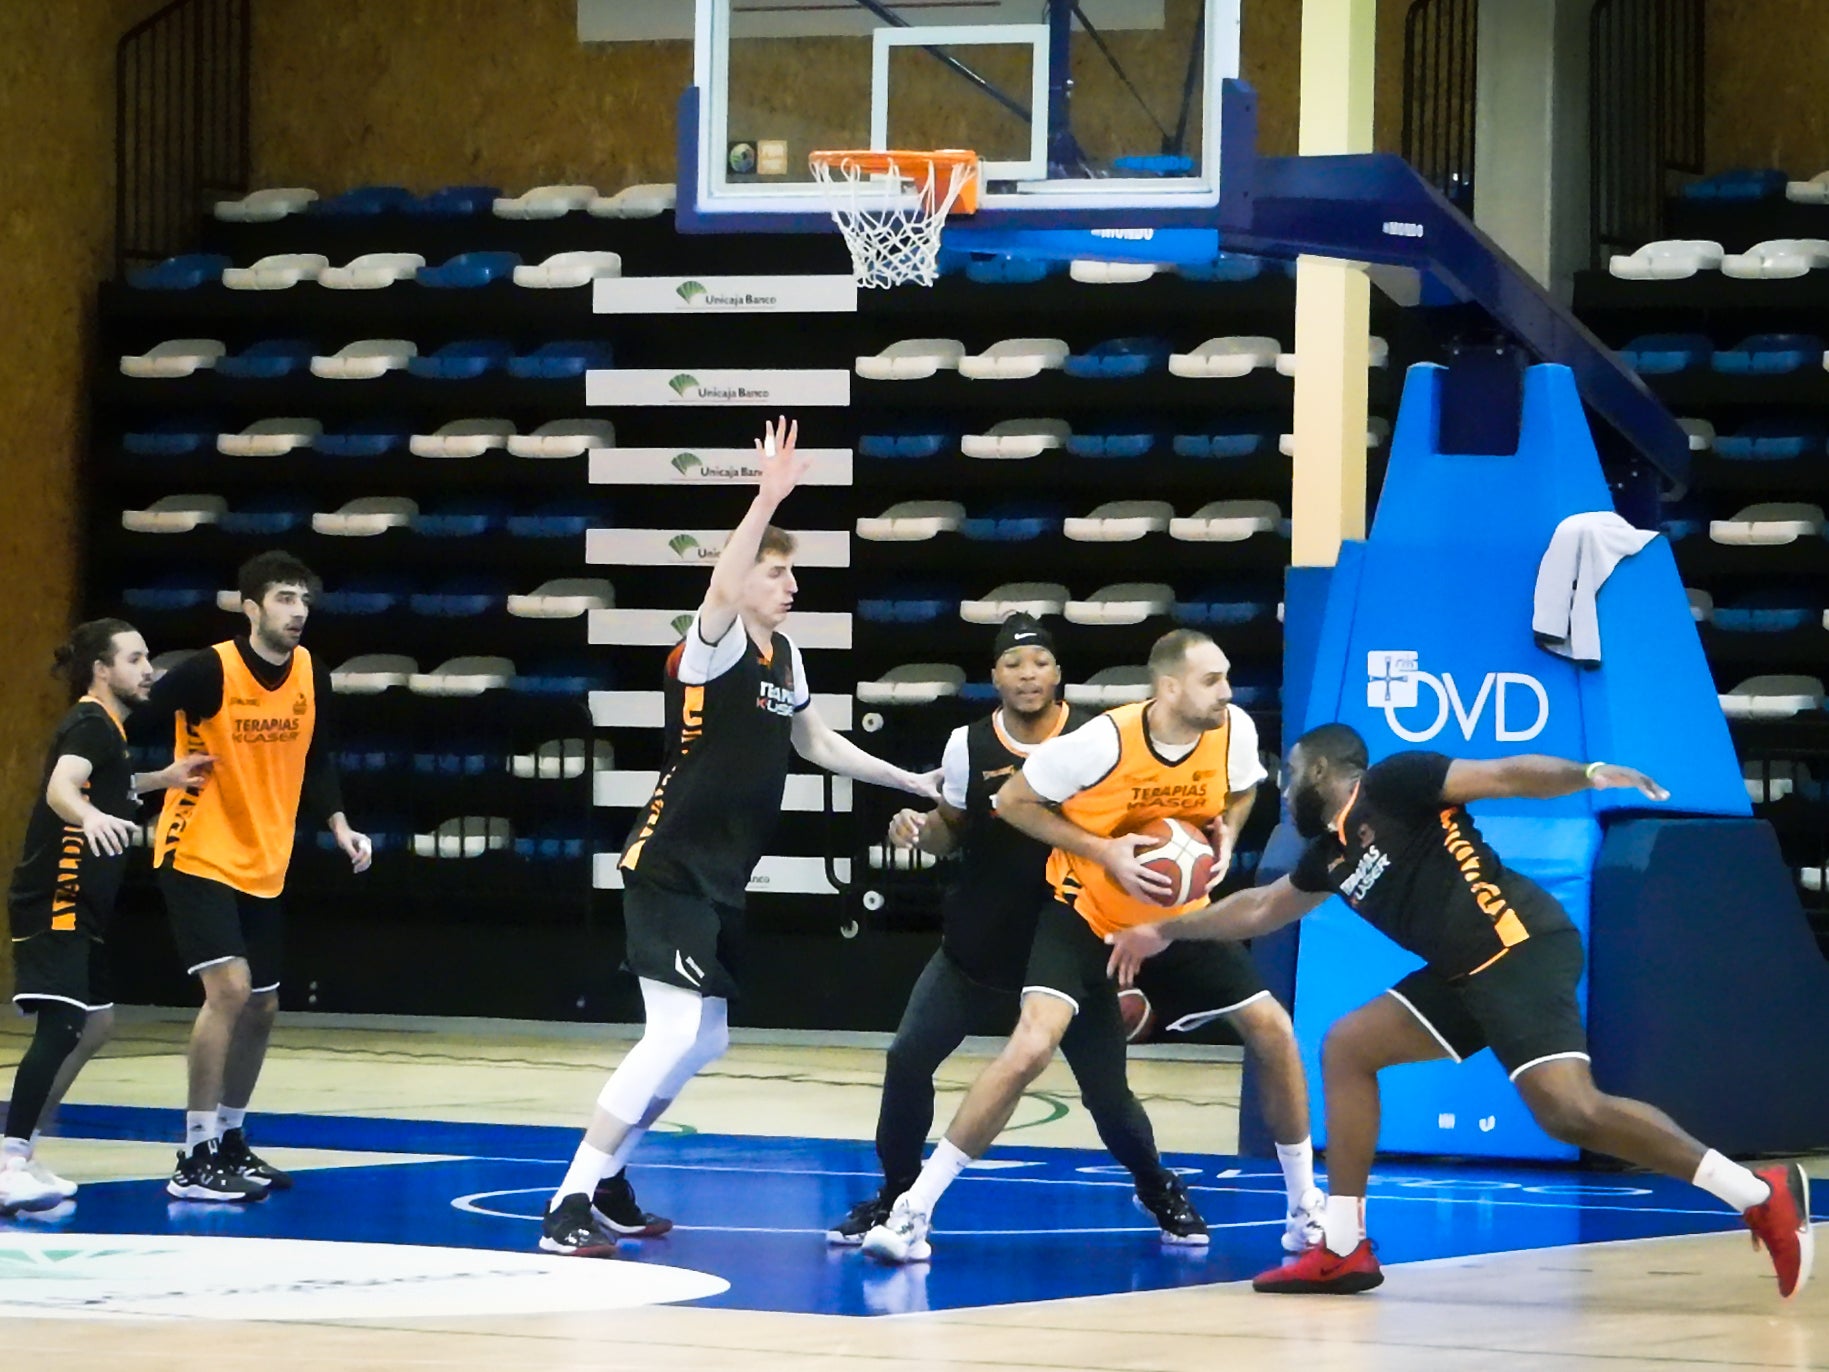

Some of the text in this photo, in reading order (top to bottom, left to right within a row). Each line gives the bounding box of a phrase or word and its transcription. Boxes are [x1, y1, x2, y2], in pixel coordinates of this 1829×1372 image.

[705, 294, 777, 306] Unicaja Banco
[698, 387, 769, 400] Unicaja Banco
[700, 466, 763, 479] Unicaja Ban
[1384, 671, 1549, 742] OVD
[234, 718, 300, 733] TERAPIAS
[1131, 783, 1208, 800] TERAPIAS
